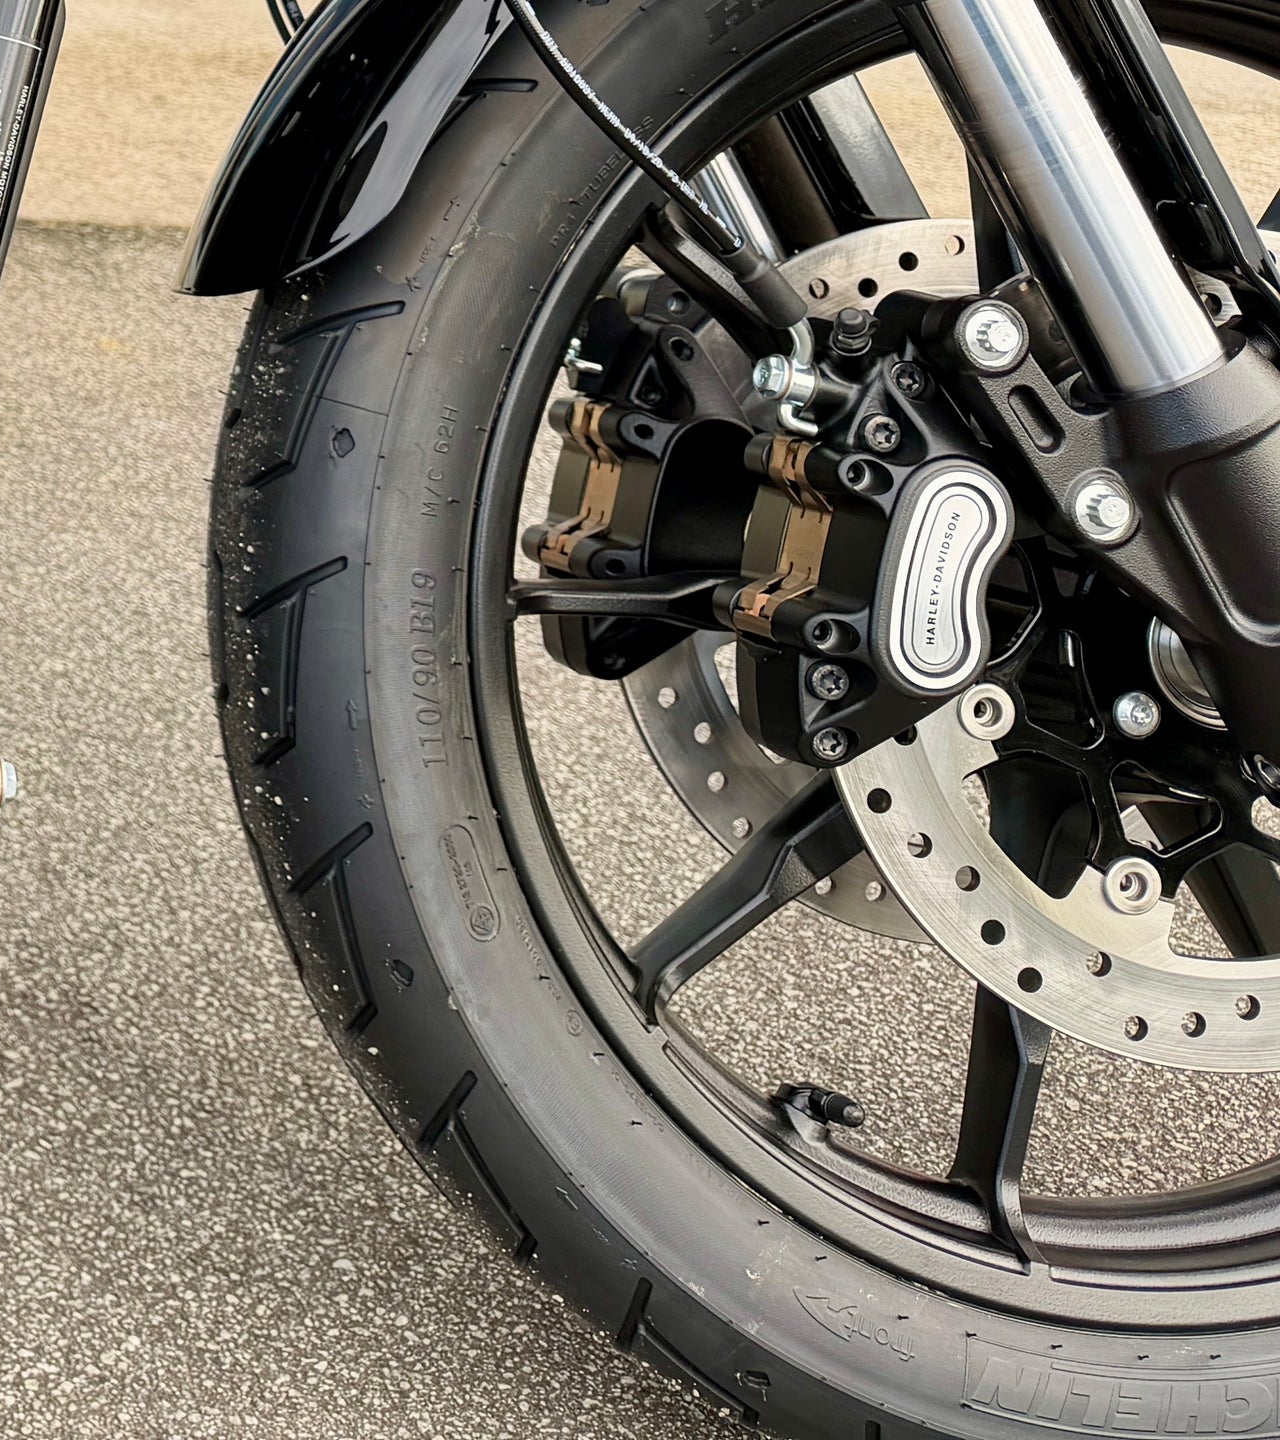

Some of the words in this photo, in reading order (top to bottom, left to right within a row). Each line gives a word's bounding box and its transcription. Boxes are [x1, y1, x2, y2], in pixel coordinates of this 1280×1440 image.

[1, 84, 29, 170] HARLEY-DAVIDSON
[578, 110, 657, 205] TUBELSS
[429, 404, 462, 455] 62H
[414, 465, 451, 519] M/C
[406, 567, 439, 635] B19
[926, 511, 962, 646] HARLEY-DAVIDSON
[402, 643, 457, 769] 110/90
[840, 1306, 918, 1363] front
